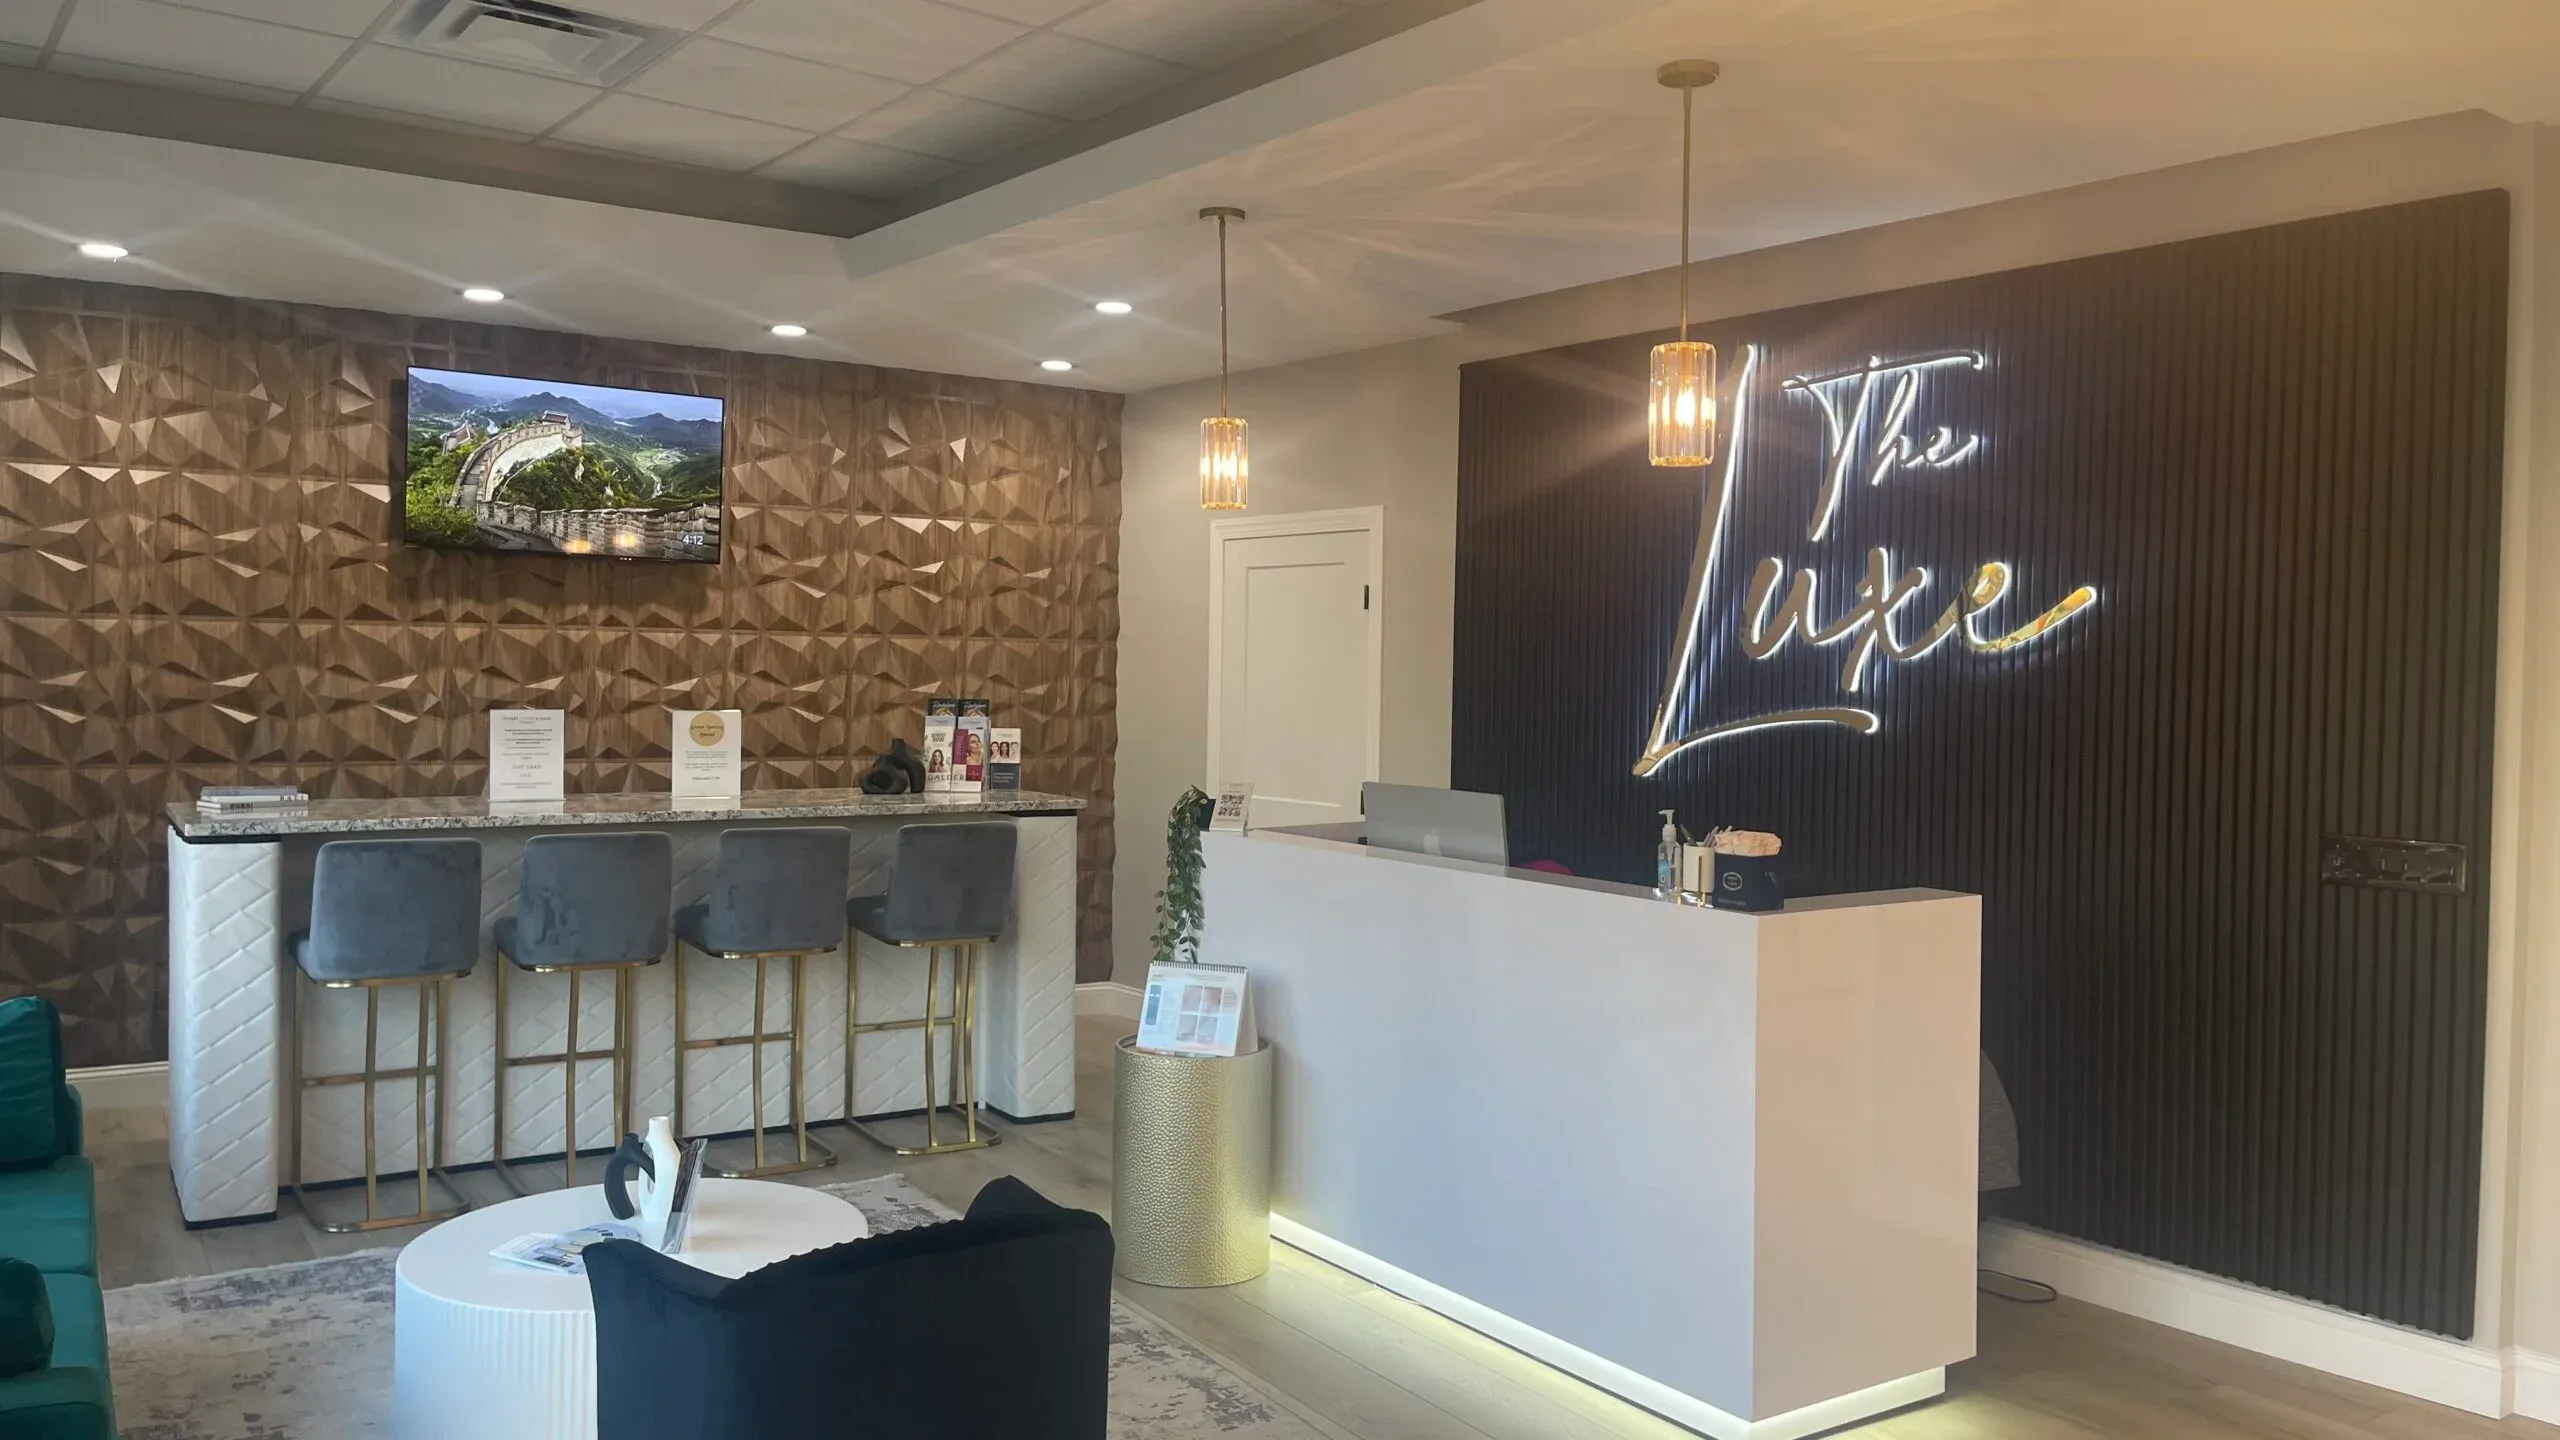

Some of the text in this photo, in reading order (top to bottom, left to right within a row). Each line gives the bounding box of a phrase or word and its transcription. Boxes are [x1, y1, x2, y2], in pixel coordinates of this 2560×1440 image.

[682, 534, 704, 545] 4:12
[1781, 351, 1984, 543] The
[1632, 344, 2098, 778] Luxe
